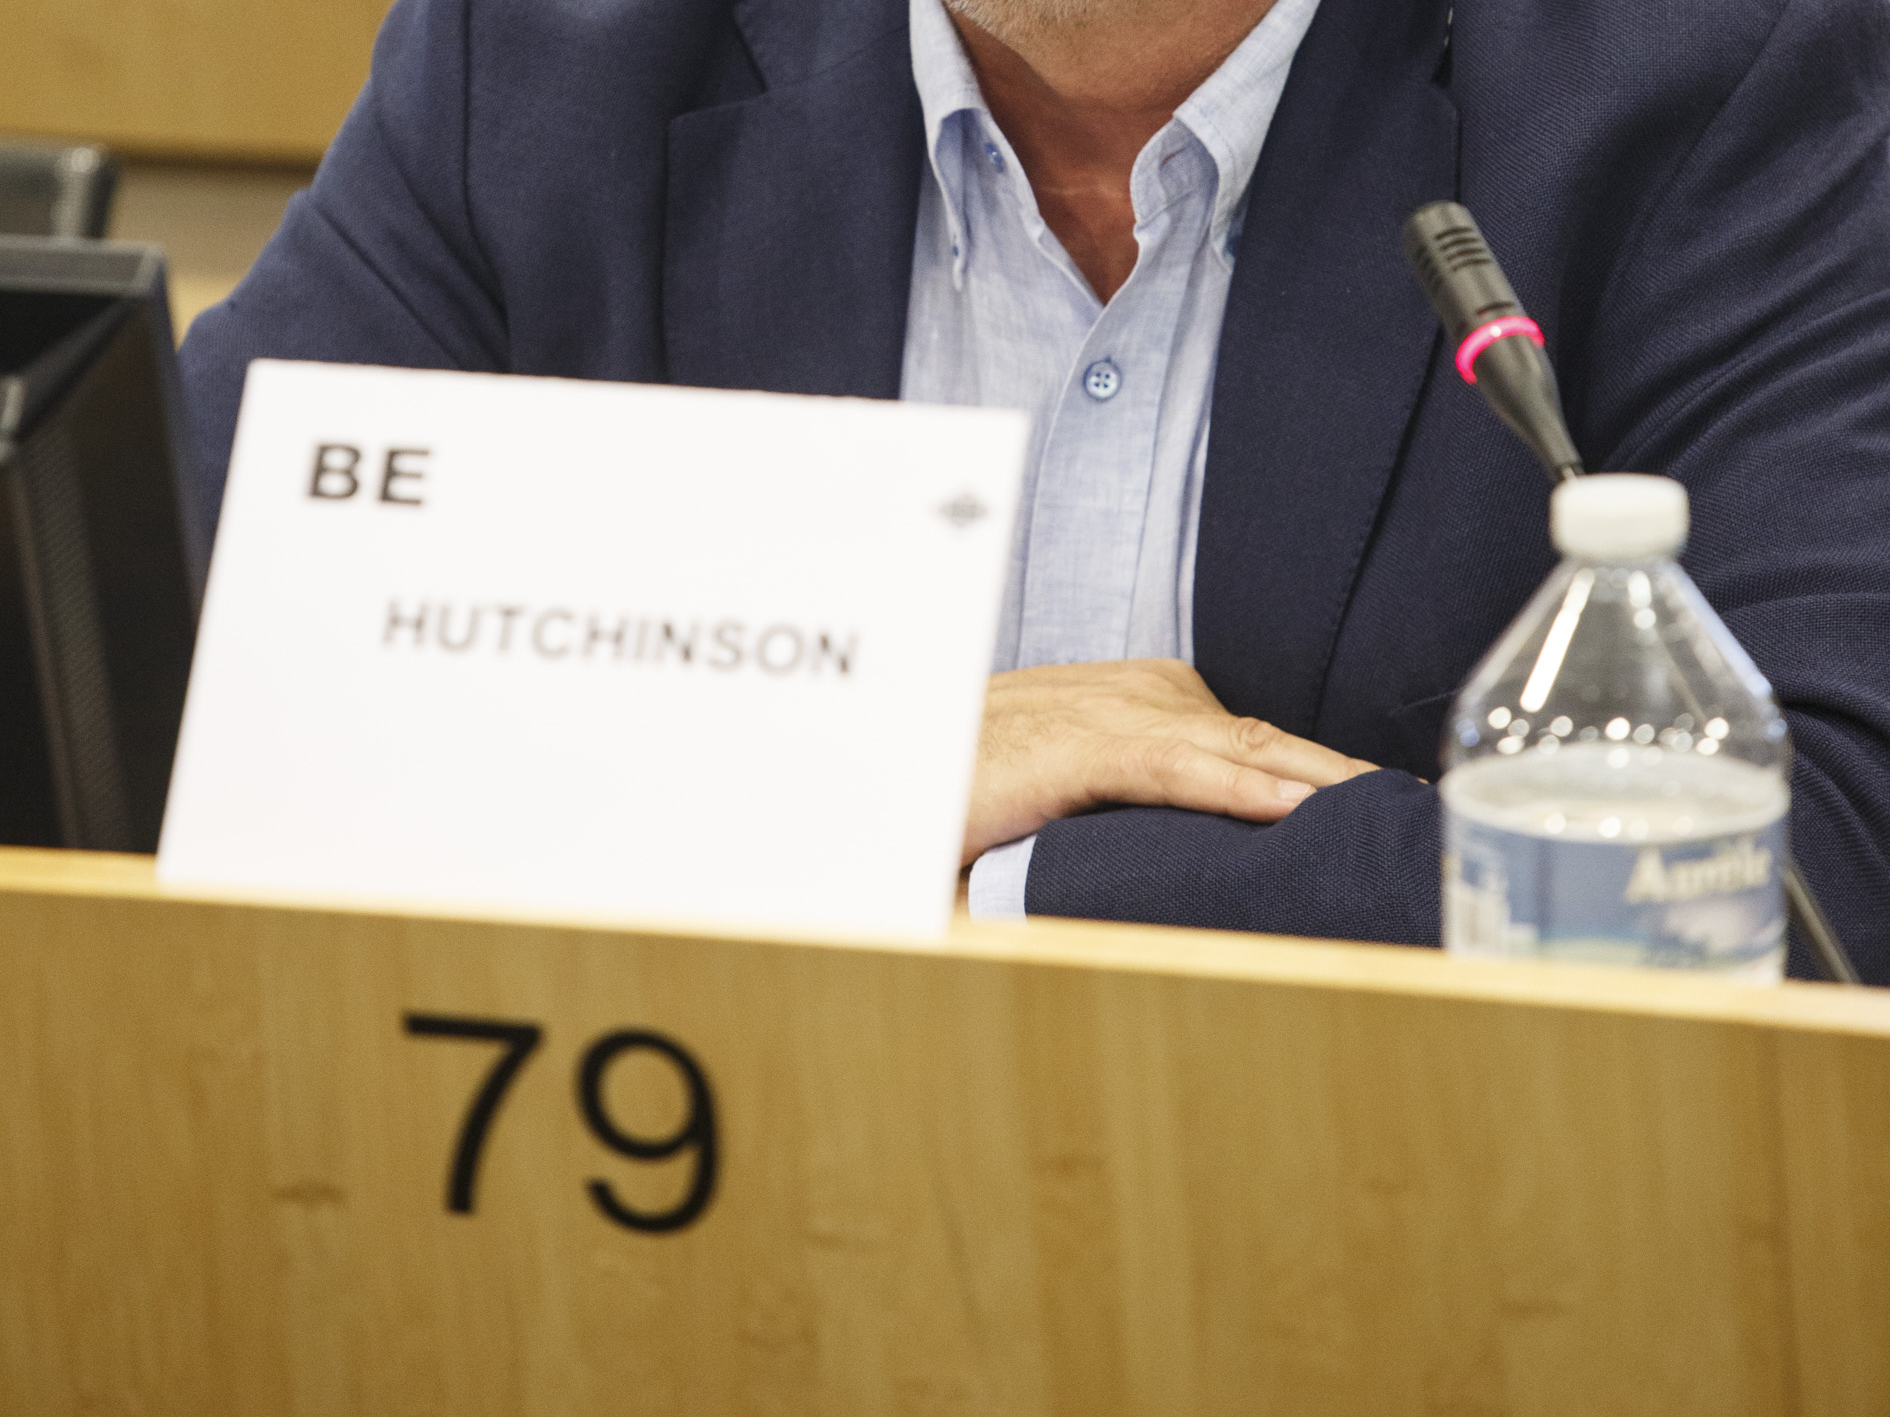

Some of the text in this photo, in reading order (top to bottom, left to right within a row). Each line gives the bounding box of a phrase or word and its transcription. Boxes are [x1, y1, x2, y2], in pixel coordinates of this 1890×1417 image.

[305, 442, 432, 508] BE
[384, 600, 858, 677] HUTCHINSON
[402, 1011, 723, 1237] 79
